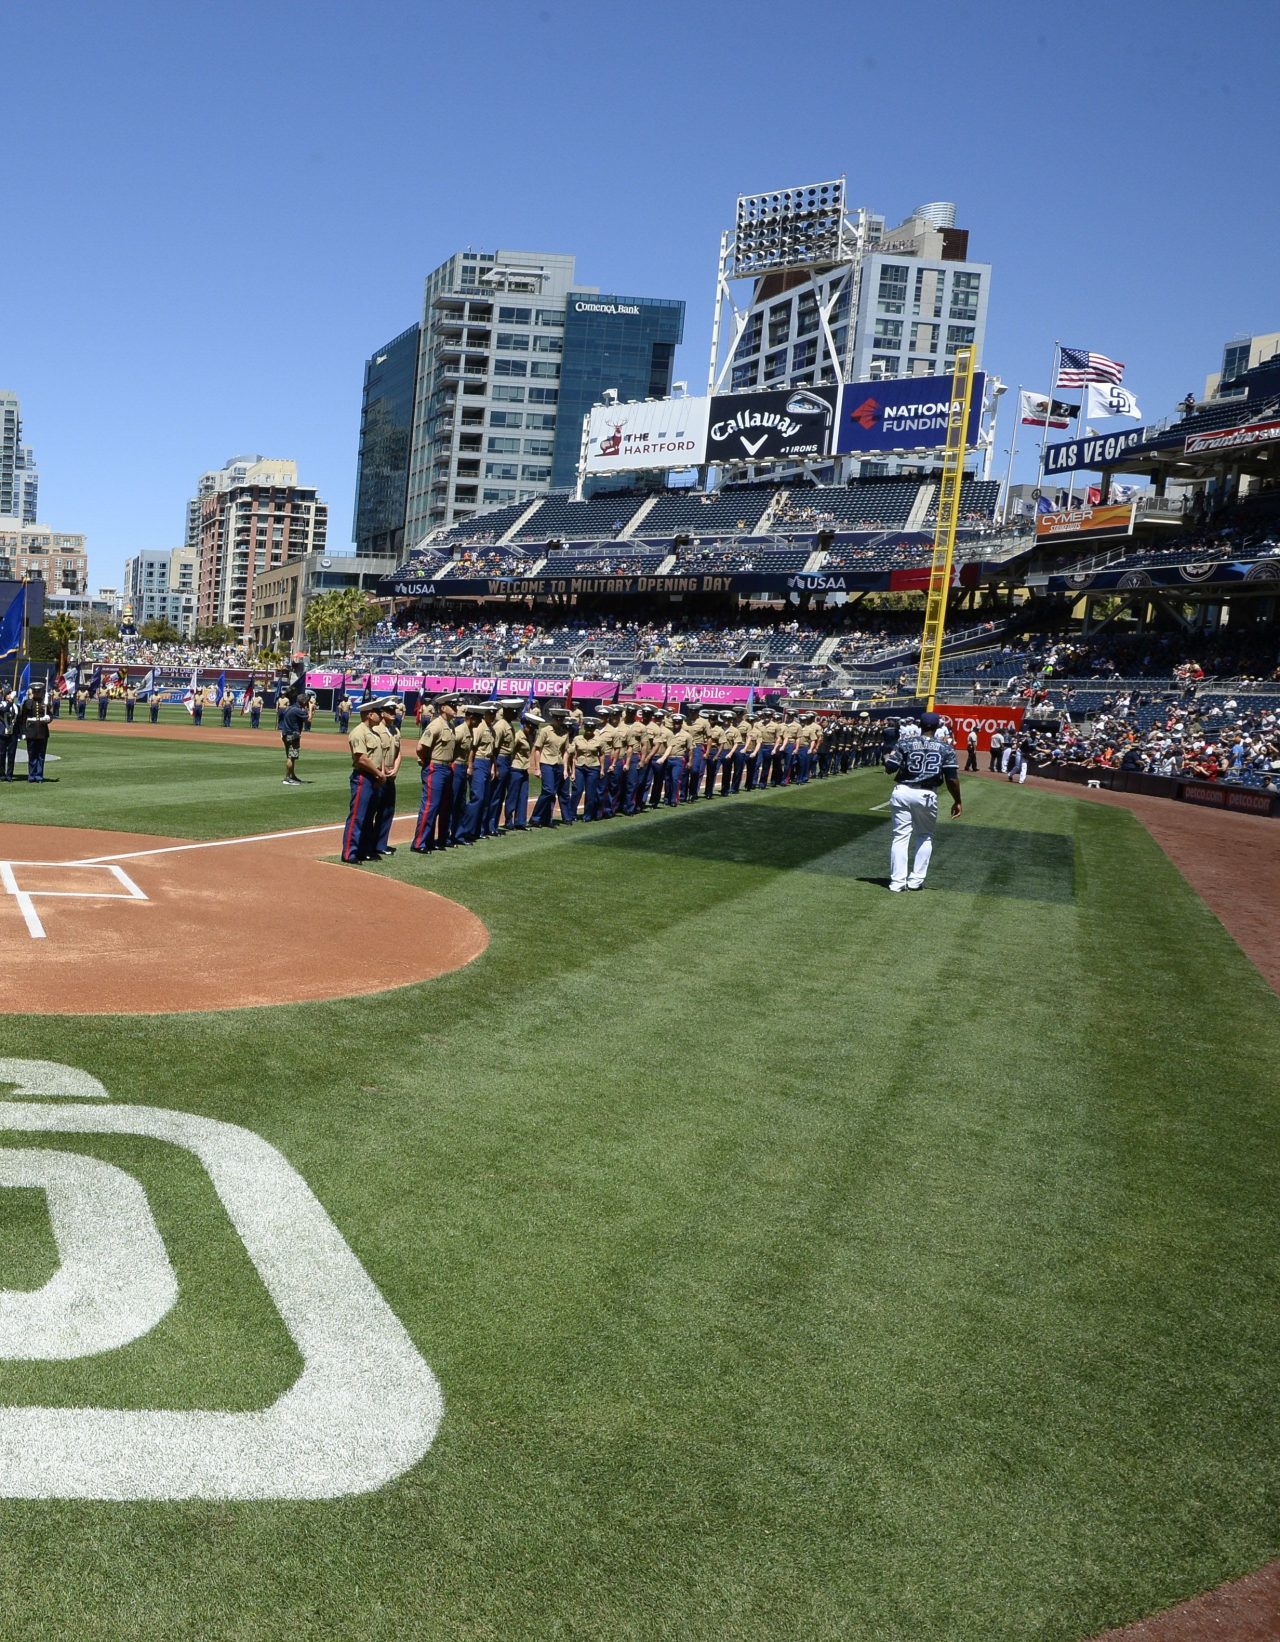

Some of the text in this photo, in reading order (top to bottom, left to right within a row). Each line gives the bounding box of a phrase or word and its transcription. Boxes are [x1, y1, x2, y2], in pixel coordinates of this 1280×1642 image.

[617, 304, 640, 315] Bank
[710, 408, 803, 441] Callaway
[883, 416, 963, 433] FUNDING
[625, 432, 650, 443] THE
[624, 441, 695, 455] HARTFORD
[790, 444, 818, 453] IRONS
[1048, 444, 1077, 470] LAS
[1042, 510, 1093, 526] CYMER
[407, 584, 436, 595] USAA
[488, 577, 732, 594] WELCOME TO MILITARY OPENING DAY
[807, 577, 846, 590] USAA
[537, 681, 570, 694] DECK
[955, 718, 1016, 734] TOYOTA
[908, 751, 942, 774] 32
[1185, 786, 1223, 802] petco.com
